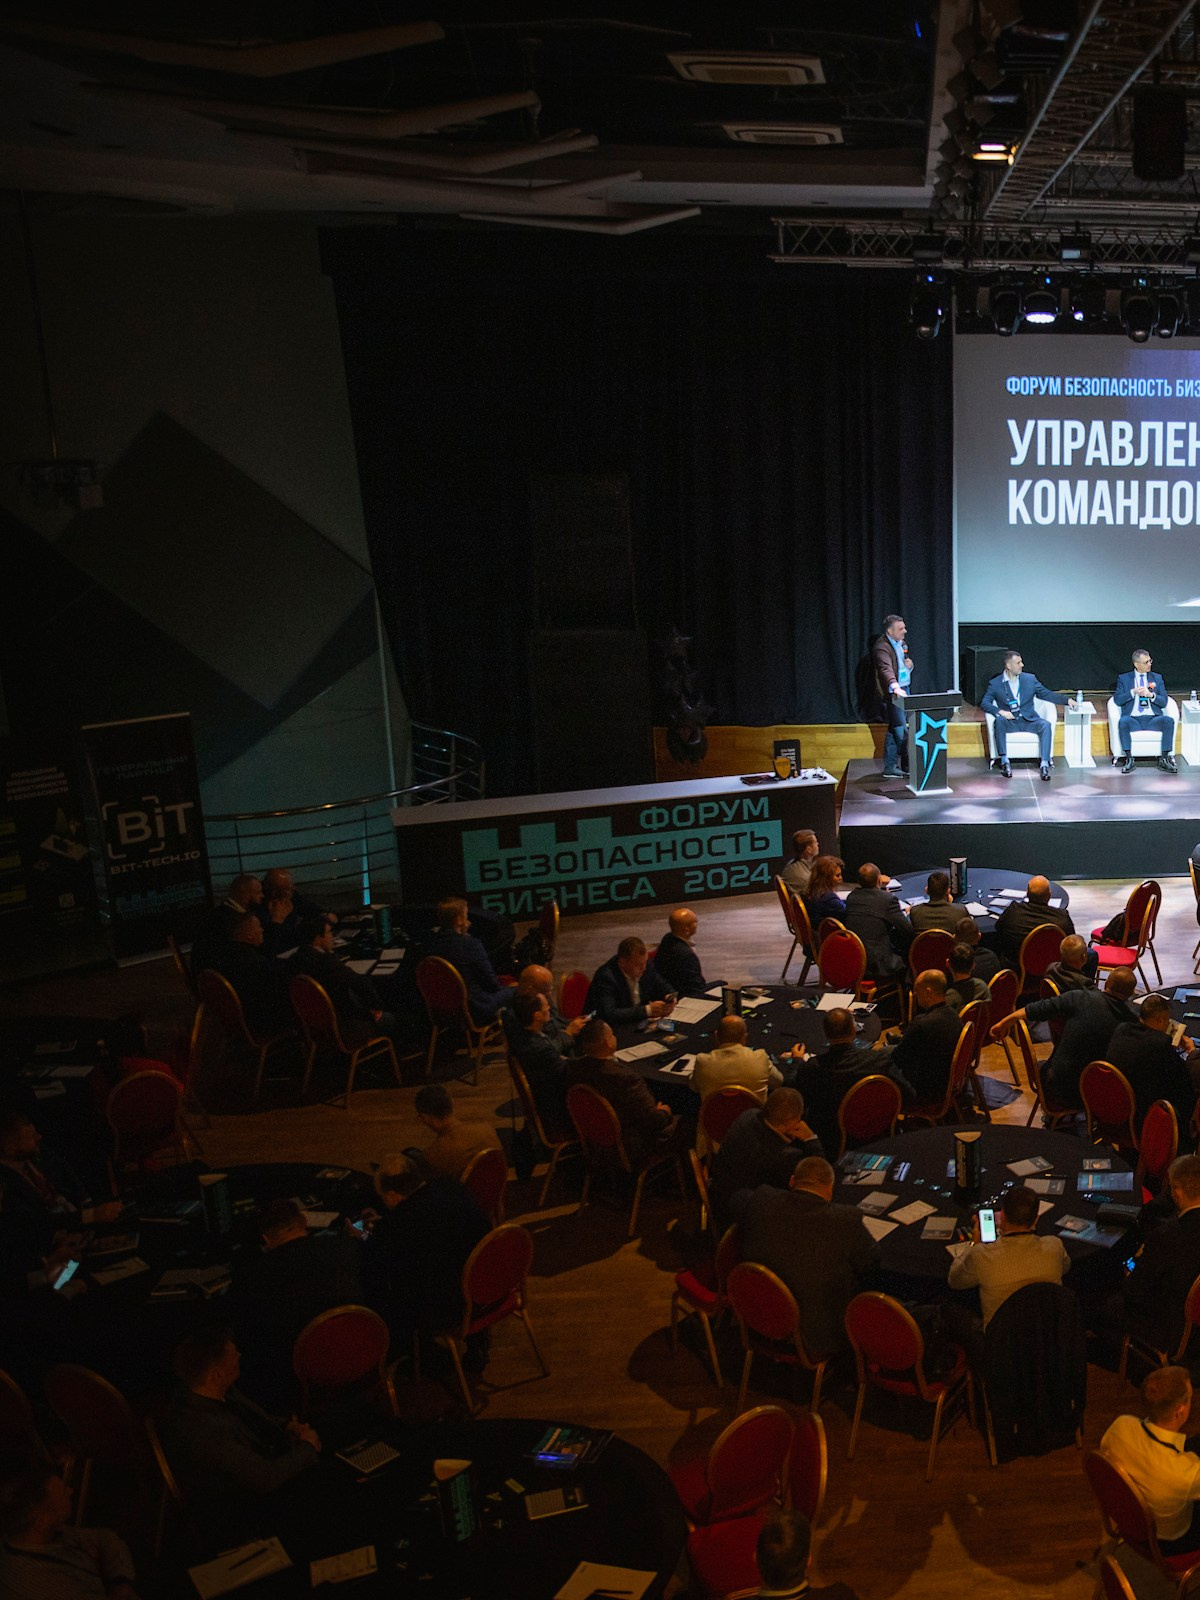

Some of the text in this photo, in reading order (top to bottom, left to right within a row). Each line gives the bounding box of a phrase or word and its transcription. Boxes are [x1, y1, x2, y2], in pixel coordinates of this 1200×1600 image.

[1006, 376, 1061, 397] ФОРУМ
[1065, 377, 1173, 398] БЕЗОПАСНОСТЬ
[639, 796, 770, 831] ФОРУМ
[110, 850, 201, 875] BIT-TECH.IO
[480, 830, 771, 883] БЕЗОПАСНОСТЬ
[482, 862, 772, 916] БИЗНЕСА 2024
